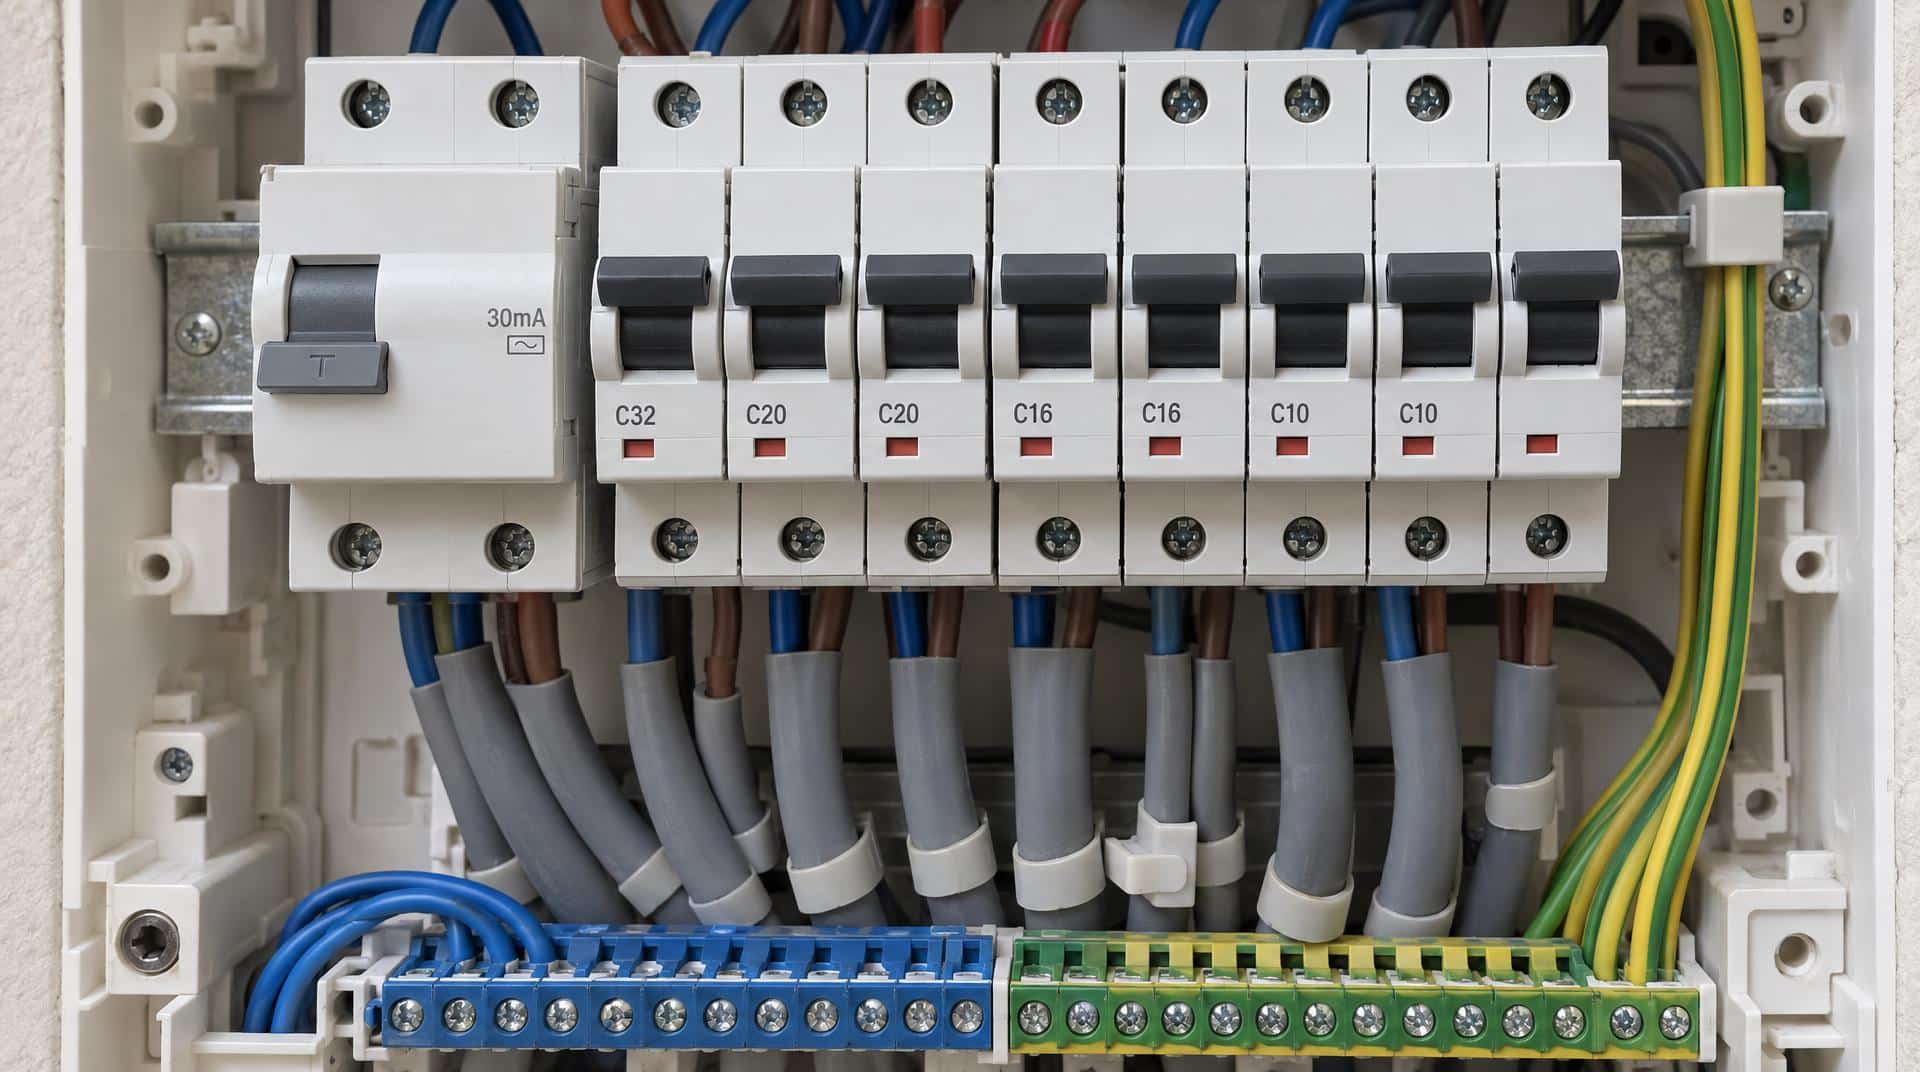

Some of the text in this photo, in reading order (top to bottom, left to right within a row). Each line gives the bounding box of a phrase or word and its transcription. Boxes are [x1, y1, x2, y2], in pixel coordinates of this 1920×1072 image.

[487, 308, 547, 328] 30mA
[615, 404, 656, 426] C32
[746, 404, 787, 425] C20
[878, 403, 919, 424] C20
[1013, 403, 1053, 424] C16
[1142, 402, 1181, 424] C16
[1271, 402, 1310, 424] C10
[1399, 402, 1438, 424] C10
